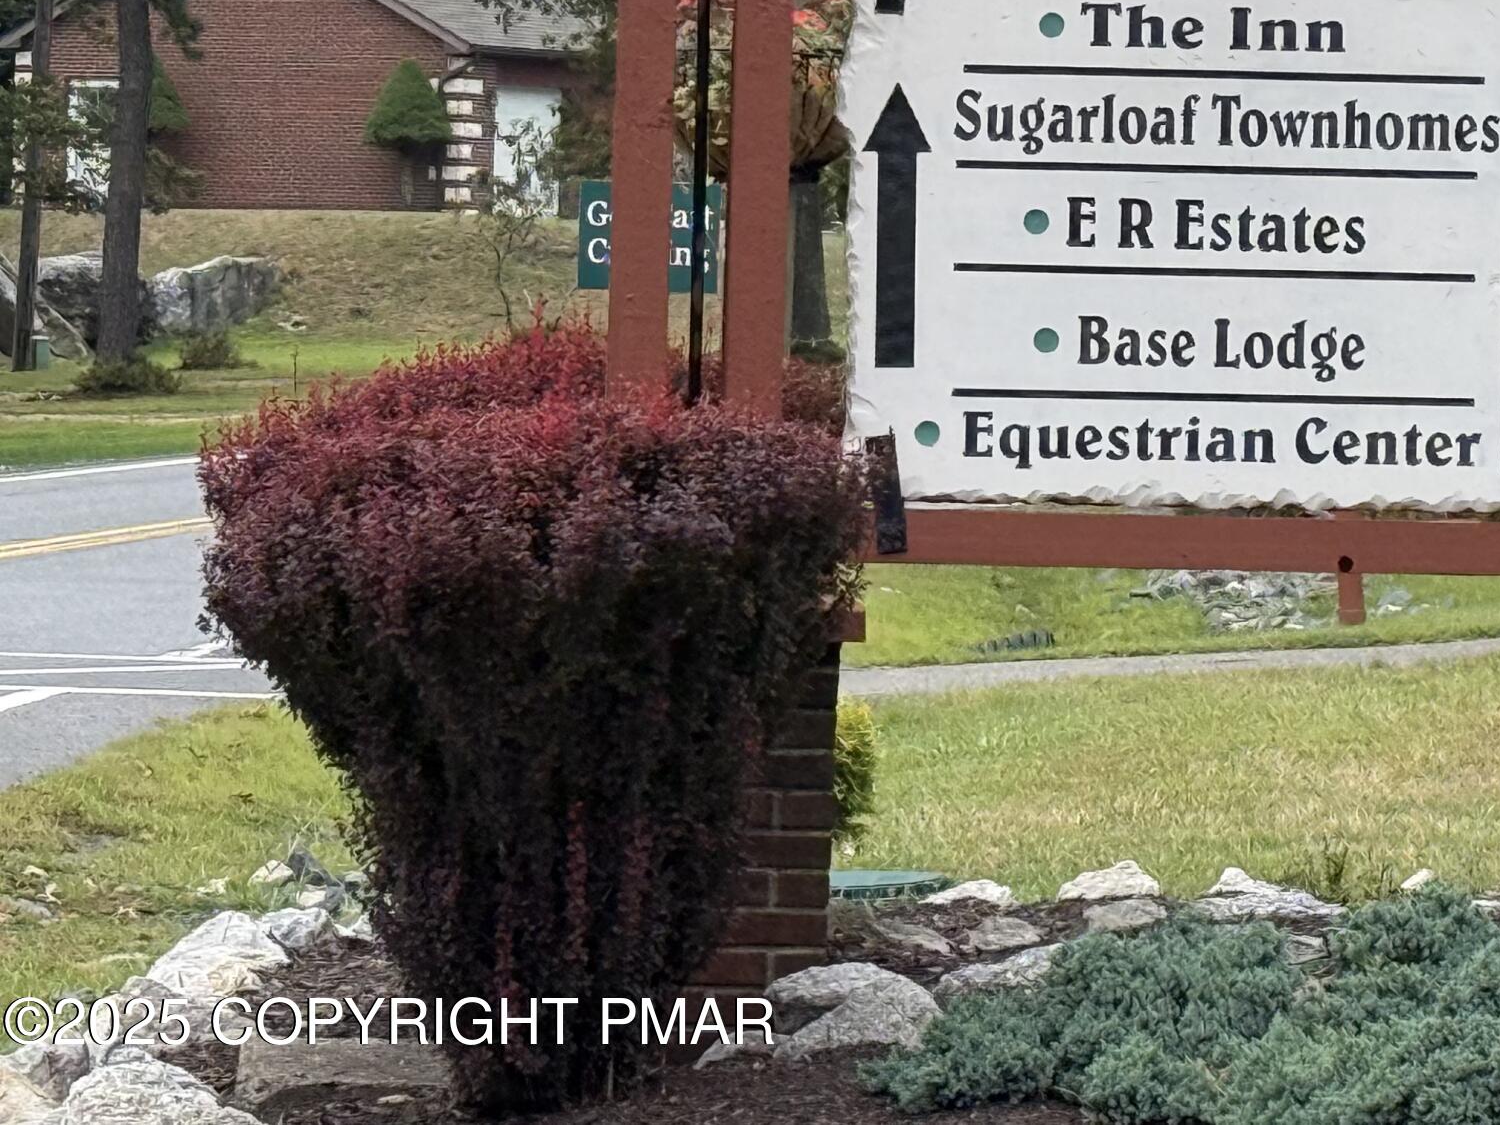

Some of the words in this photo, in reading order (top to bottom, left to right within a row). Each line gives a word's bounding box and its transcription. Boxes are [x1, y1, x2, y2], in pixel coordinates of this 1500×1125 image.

[1081, 3, 1203, 49] The
[1230, 7, 1345, 52] Inn
[954, 90, 1200, 154] Sugarloaf
[1212, 94, 1500, 152] Townhomes
[1067, 197, 1095, 247] E
[1118, 198, 1153, 248] R
[1175, 199, 1365, 254] Estates
[1078, 316, 1195, 367] Base
[1215, 319, 1364, 382] Lodge
[963, 412, 1275, 468] Equestrian
[1296, 418, 1481, 466] Center
